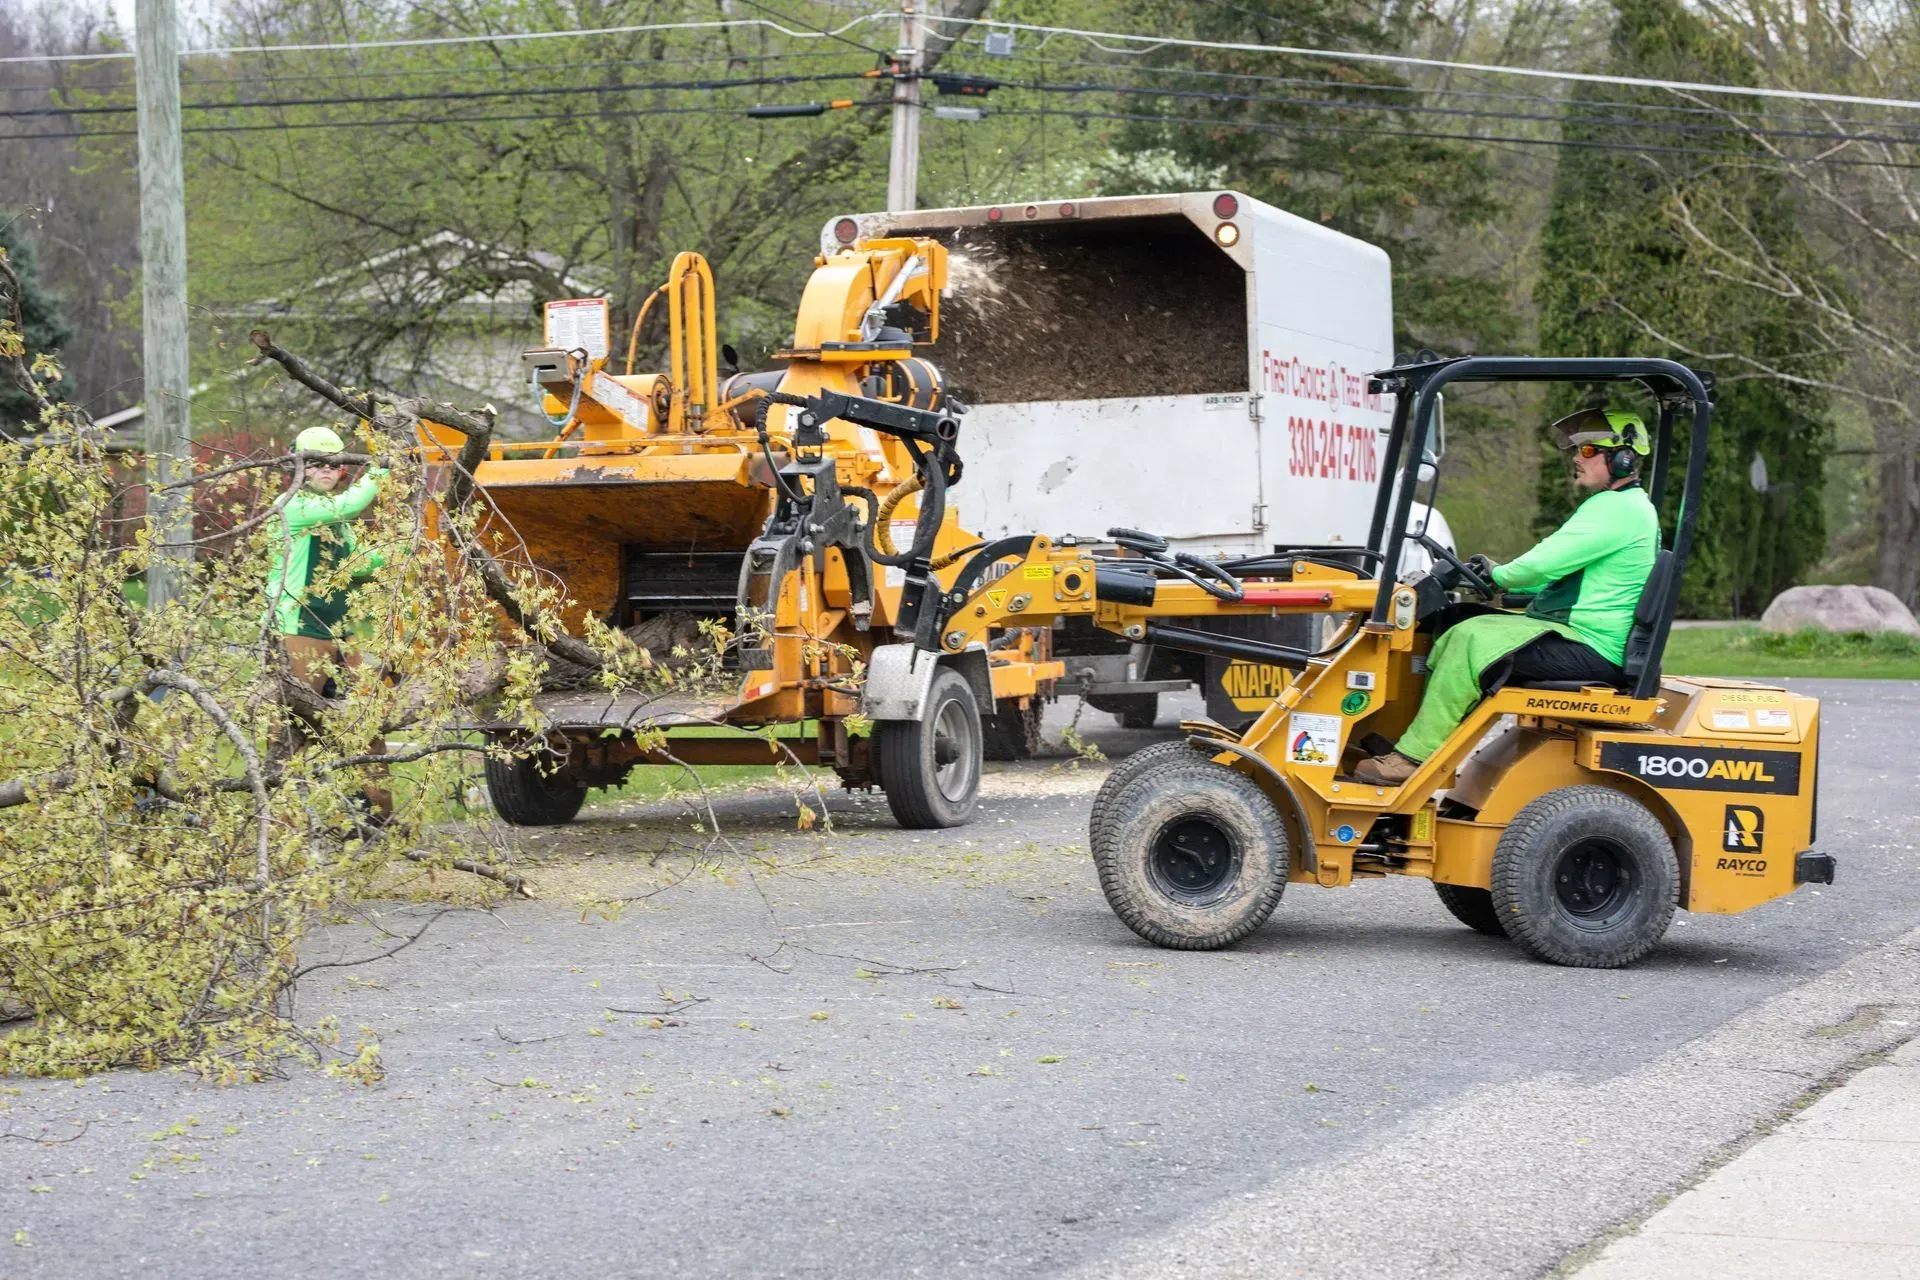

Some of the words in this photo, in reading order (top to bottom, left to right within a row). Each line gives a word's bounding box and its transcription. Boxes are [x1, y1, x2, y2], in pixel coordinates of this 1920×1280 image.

[1292, 356, 1327, 402] CHOICE
[1288, 416, 1376, 483] 330-247-2706
[1233, 665, 1282, 697] NAPA
[1526, 697, 1631, 716] RAYCOMFG.COM
[1716, 858, 1767, 872] RAYCO
